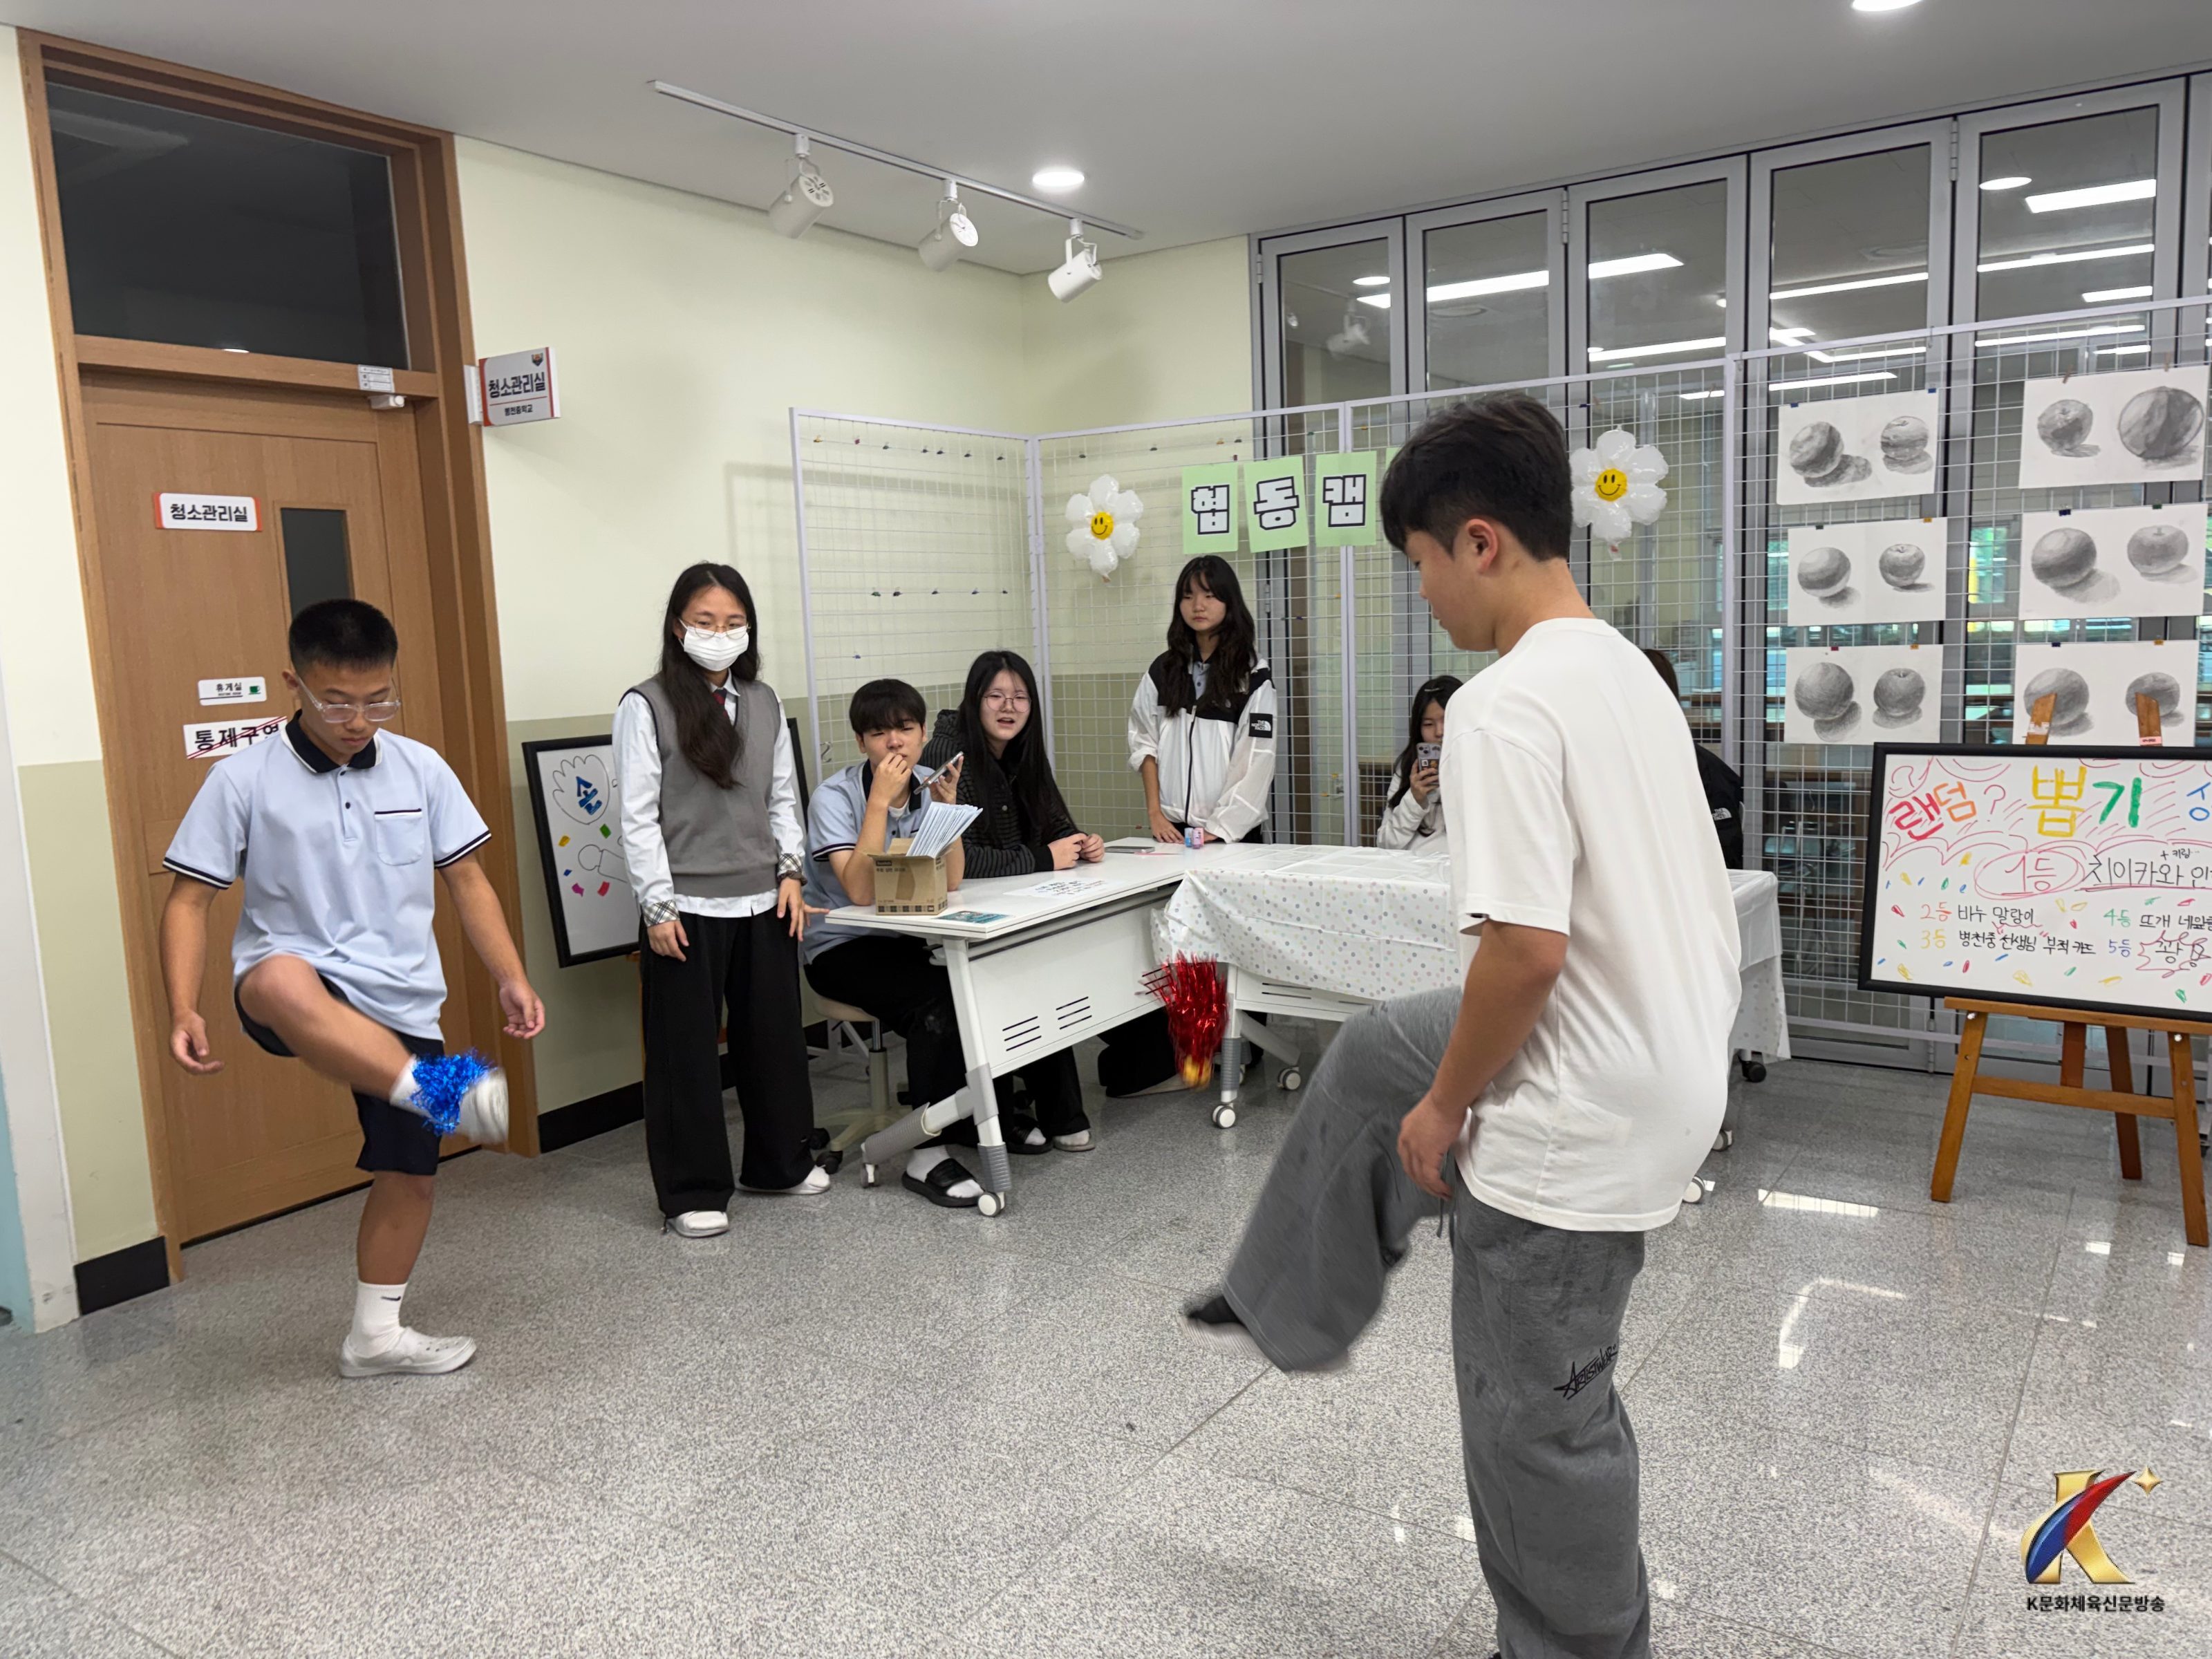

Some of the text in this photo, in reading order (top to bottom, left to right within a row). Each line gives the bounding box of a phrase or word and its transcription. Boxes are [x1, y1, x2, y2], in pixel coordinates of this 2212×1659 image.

[488, 371, 546, 399] 청소관리실
[169, 503, 249, 523] 청소관리실
[216, 682, 243, 692] 휴게실
[2026, 765, 2142, 837] 뽑기
[2005, 854, 2057, 892] 1등
[1920, 901, 1952, 922] 2등
[1992, 907, 2034, 925] 말랑이
[2103, 908, 2130, 928] 4등
[2139, 914, 2171, 928] 뜨개
[1920, 929, 1947, 949] 3등
[1959, 930, 1996, 948] 병천중
[2043, 937, 2069, 955] 부적
[2108, 939, 2131, 958] 5등
